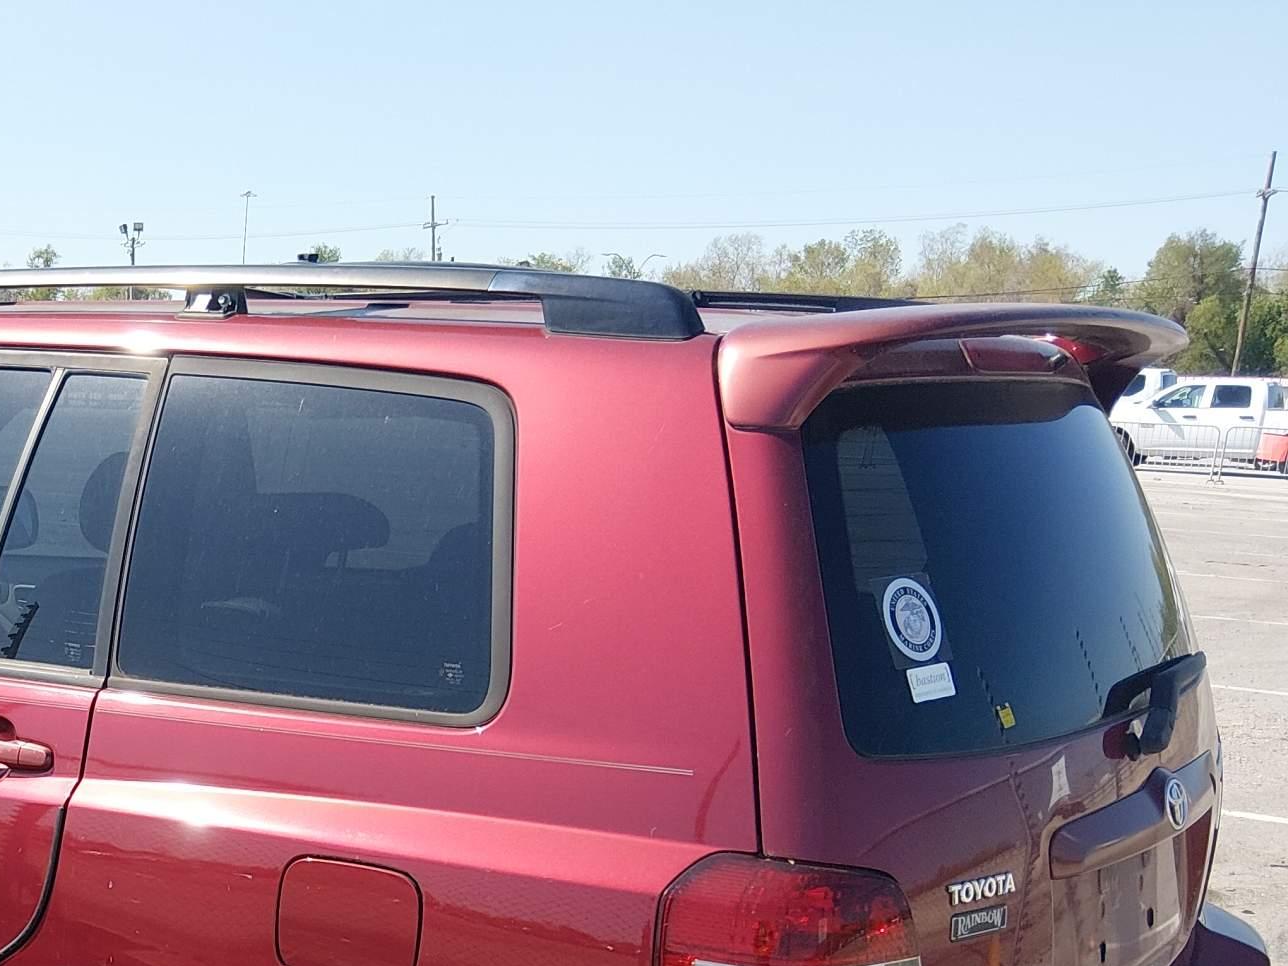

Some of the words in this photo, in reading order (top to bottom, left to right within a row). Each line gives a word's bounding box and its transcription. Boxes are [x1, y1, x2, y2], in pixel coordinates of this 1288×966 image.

[906, 587, 928, 607] STATES
[899, 633, 925, 652] MARINE
[947, 872, 1016, 906] TOYOTA
[958, 907, 1004, 935] RAINBOW
